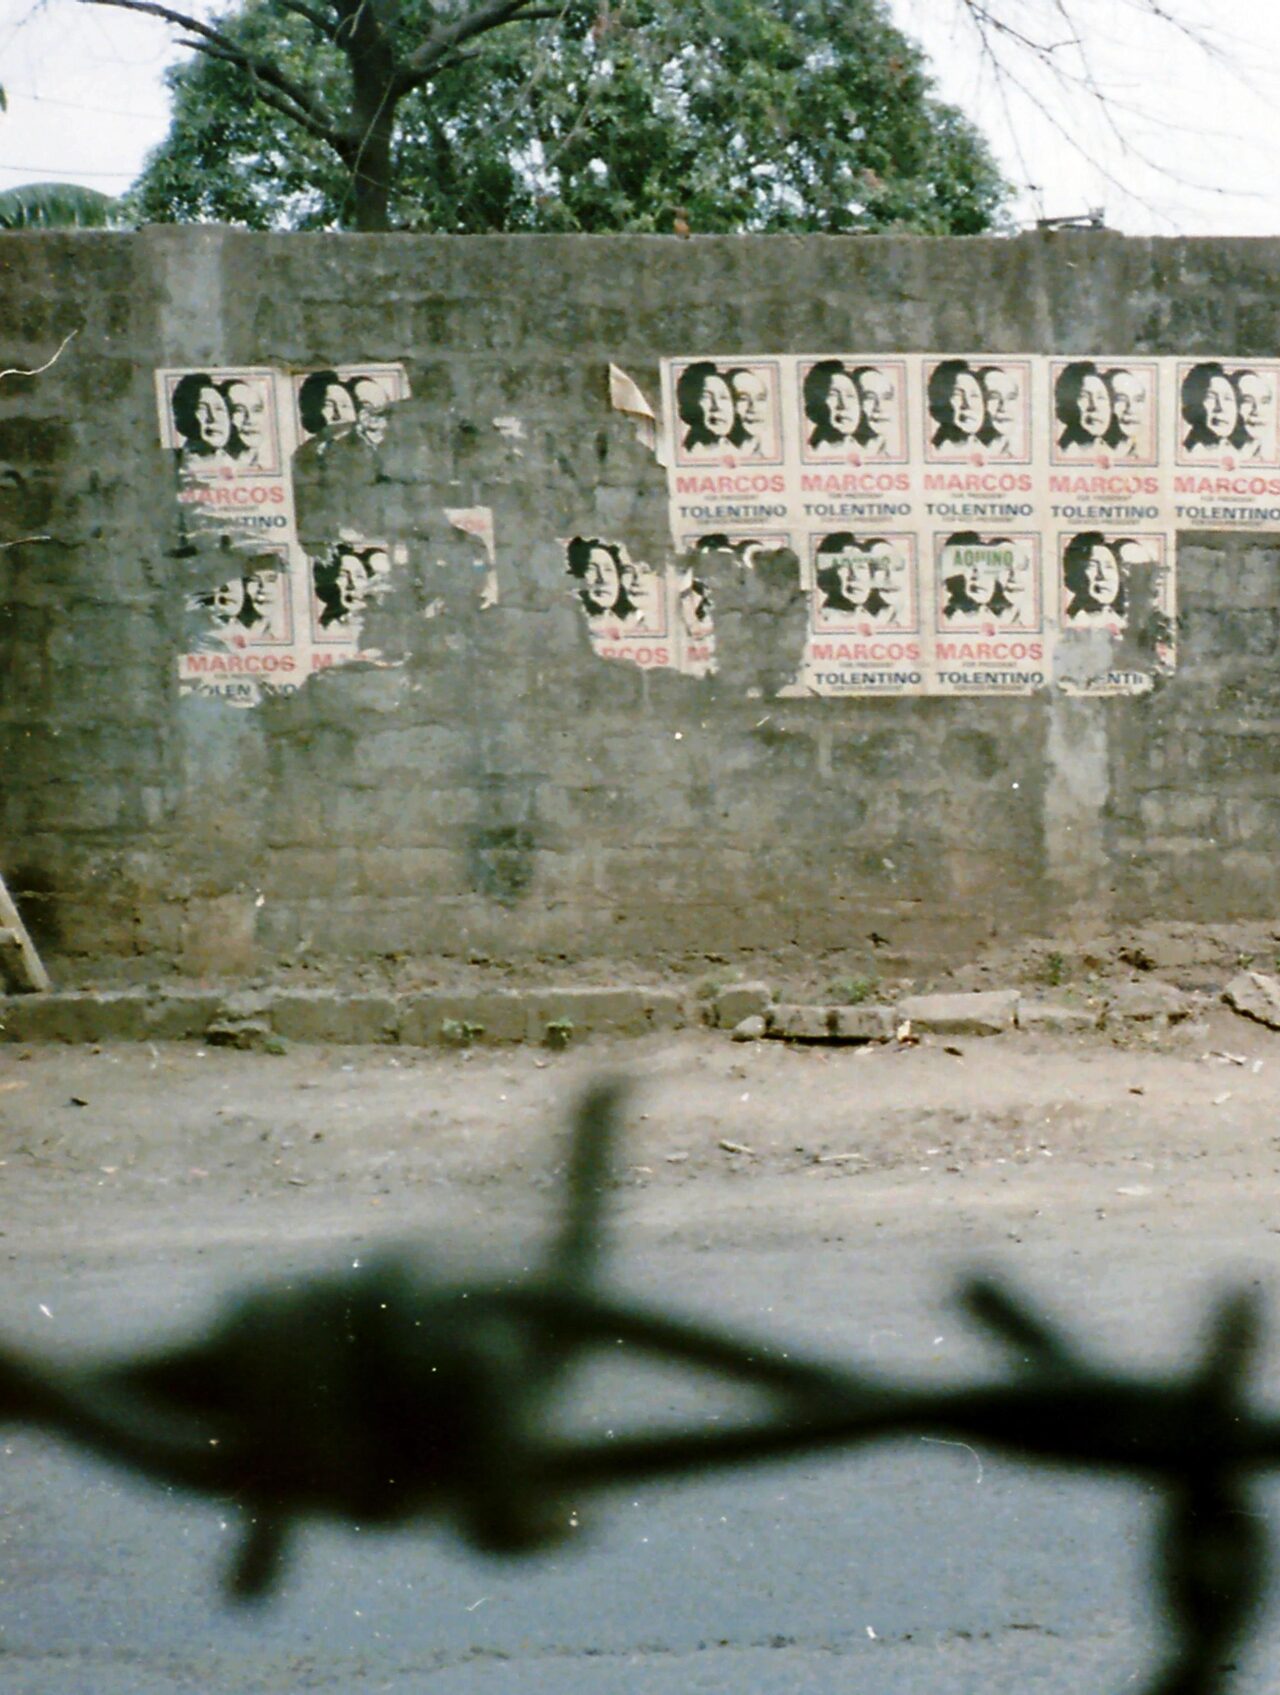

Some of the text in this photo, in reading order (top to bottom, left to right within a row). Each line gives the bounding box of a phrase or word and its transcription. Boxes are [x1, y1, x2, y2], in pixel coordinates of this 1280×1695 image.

[676, 475, 785, 493] MARCOS
[800, 474, 910, 492] MARCOS
[923, 474, 1033, 492] MARCOS
[1048, 475, 1159, 494] MARCOS
[679, 504, 787, 518] TOLENTINO
[804, 503, 911, 516] TOLENTINO
[926, 503, 1033, 516] TOLENTINO
[1051, 505, 1159, 518] TOLENTINO
[812, 643, 921, 660] MARCOS
[935, 643, 1043, 660] MARCOS
[187, 655, 296, 672] MARCOS
[815, 672, 922, 685] TOLENTINO
[937, 671, 1044, 684] TOLENTINO
